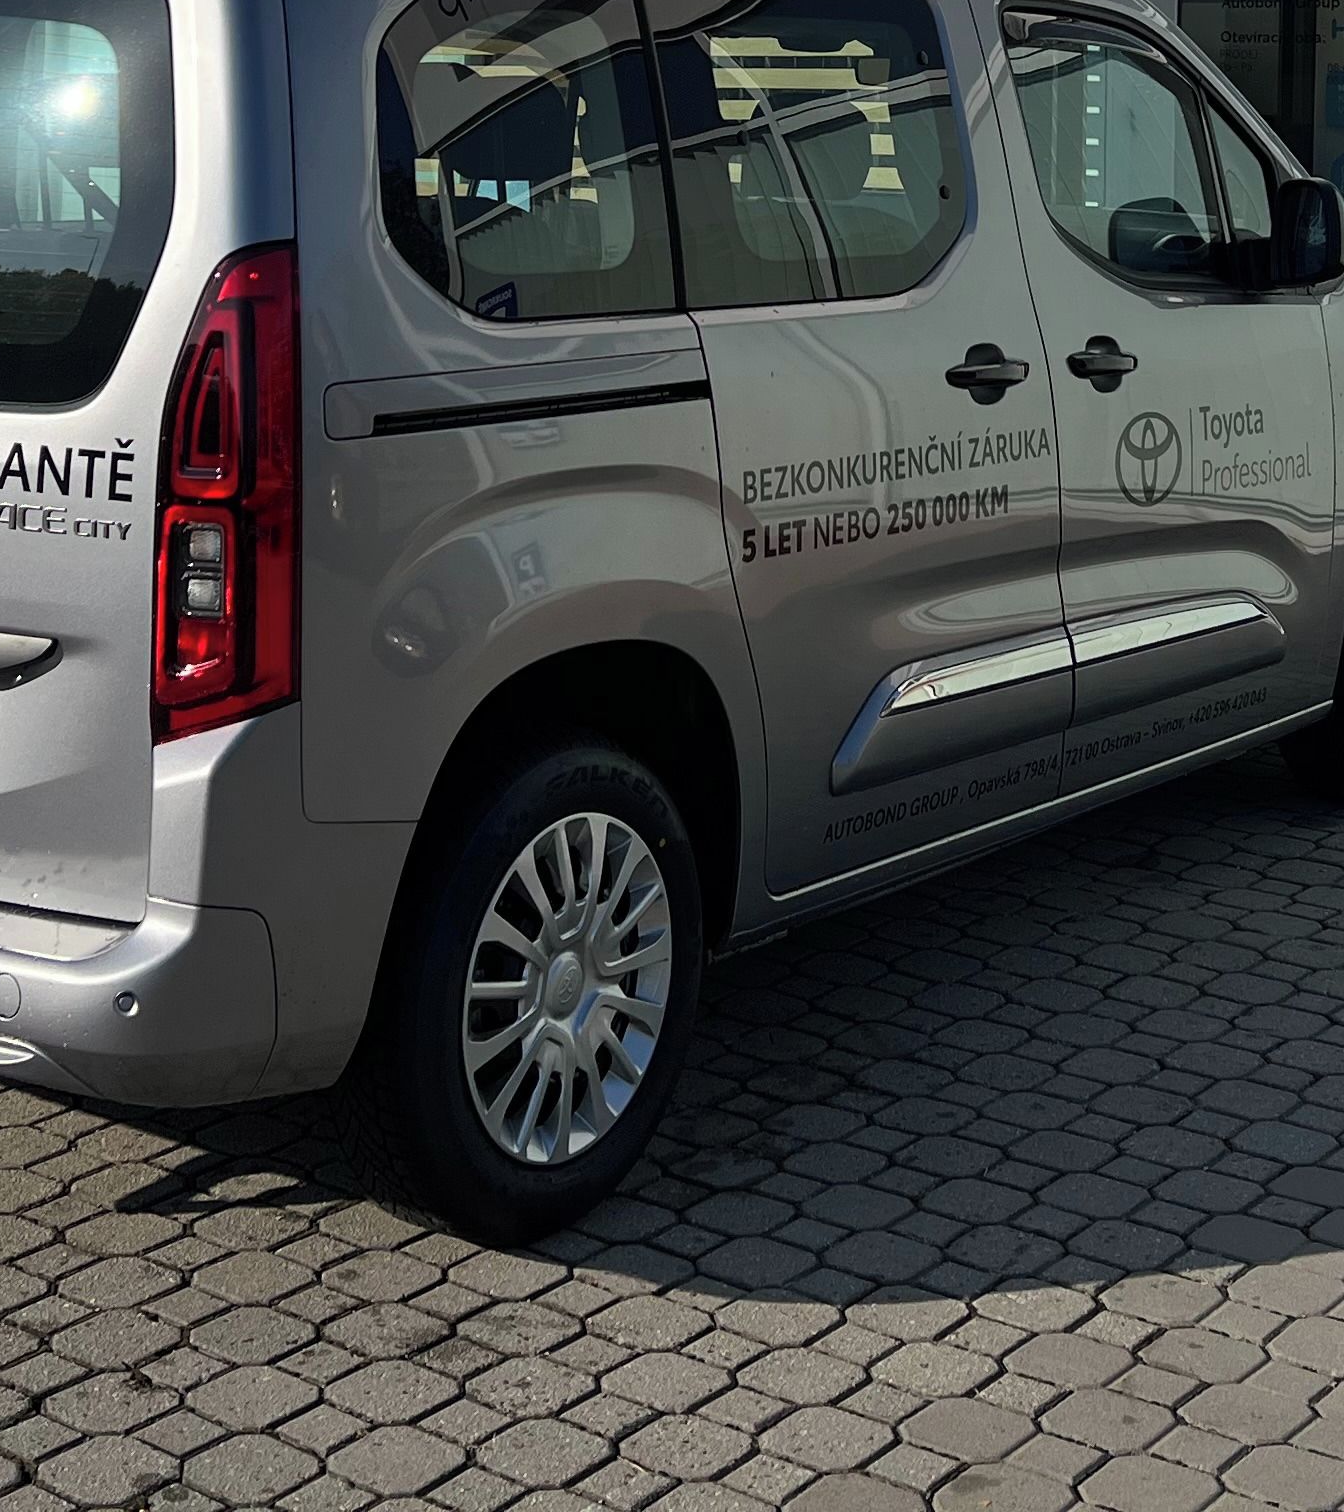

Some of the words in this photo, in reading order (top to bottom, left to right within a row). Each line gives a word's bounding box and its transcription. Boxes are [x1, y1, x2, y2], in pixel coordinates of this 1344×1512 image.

[1199, 403, 1265, 448] Toyota
[742, 431, 963, 505] BEZKONKURENČNÍ
[968, 426, 1052, 469] ZÁRUKA
[1202, 441, 1312, 495] Professional
[73, 517, 132, 541] CITY
[741, 528, 756, 563] 5
[763, 518, 807, 558] LET
[813, 506, 881, 550] NEBO
[887, 498, 927, 536] 250
[931, 490, 970, 526] 000
[975, 484, 1009, 520] KM
[822, 802, 906, 845] AUTOBOND
[967, 765, 1021, 801] Opavská
[1065, 748, 1084, 767] 721
[1085, 740, 1099, 761] 00
[1100, 729, 1142, 755] Ostrava
[1212, 698, 1231, 718] 596
